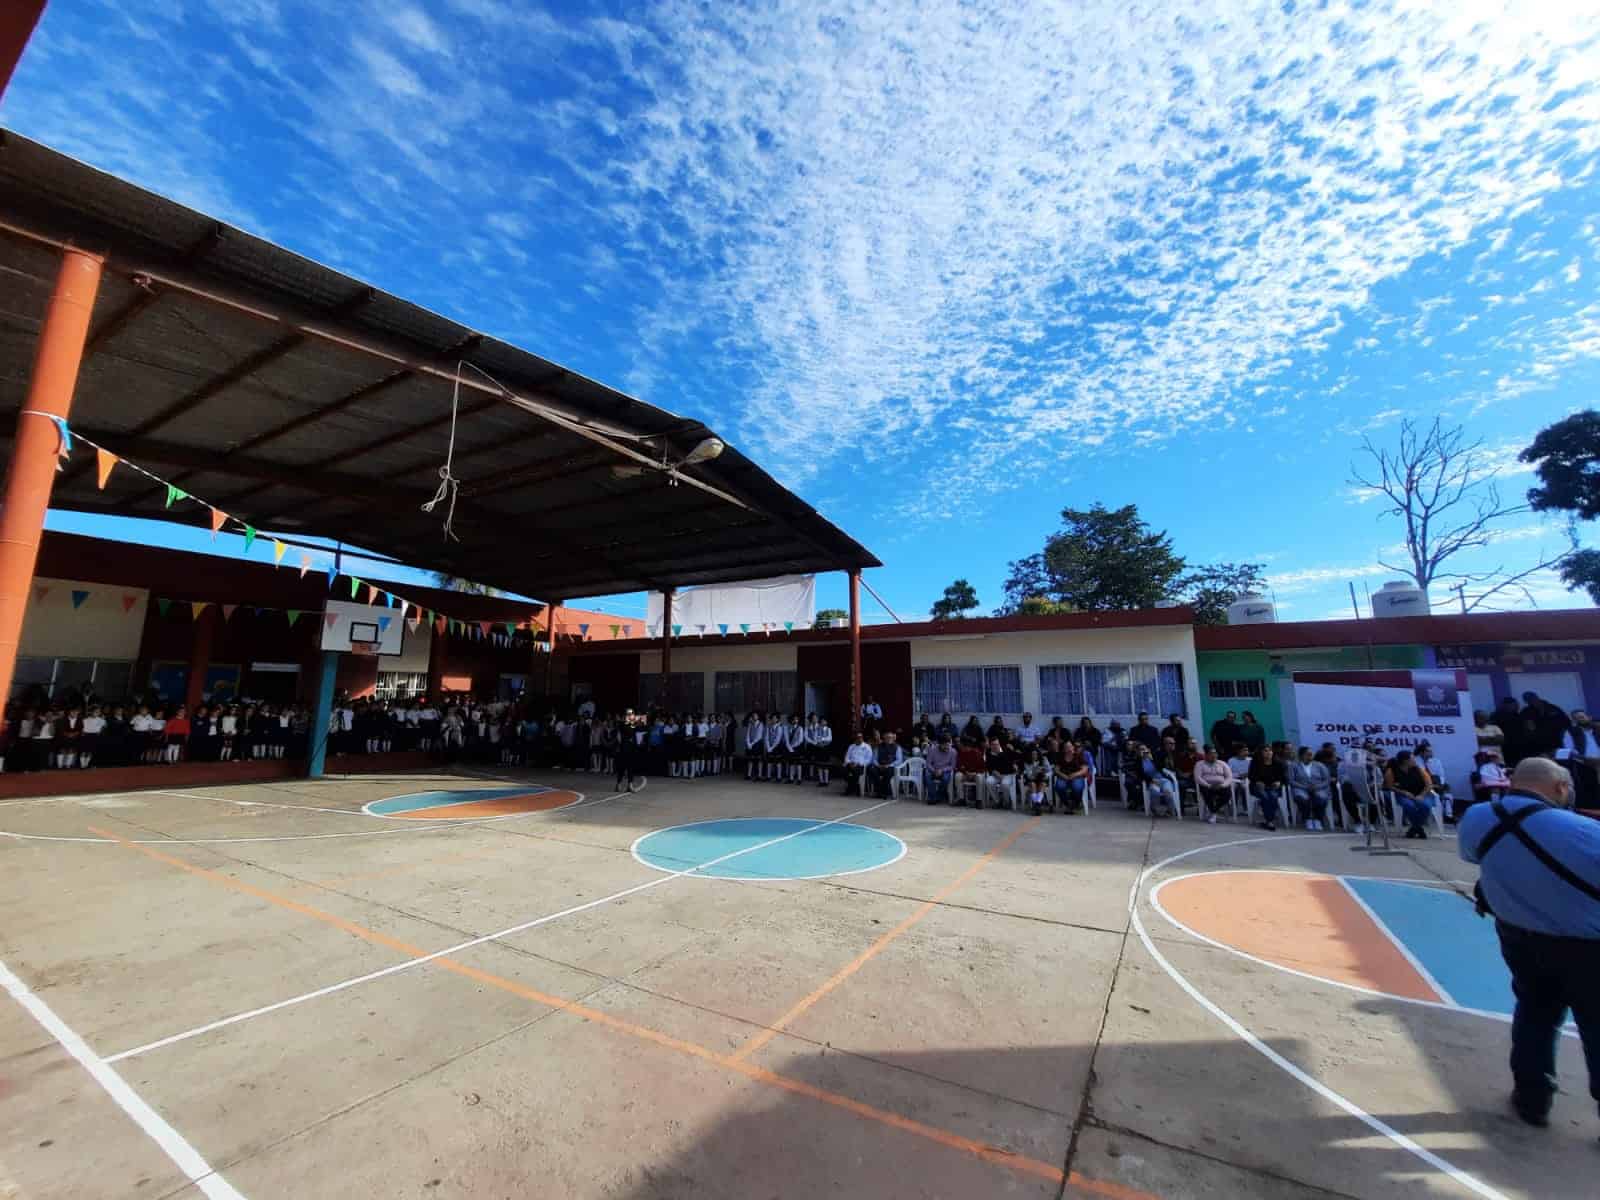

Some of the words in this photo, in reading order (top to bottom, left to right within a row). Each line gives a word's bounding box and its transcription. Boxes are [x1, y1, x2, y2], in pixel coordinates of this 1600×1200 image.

[1315, 723, 1358, 732] ZONA
[1363, 724, 1384, 733] DE
[1388, 724, 1456, 734] PADRES
